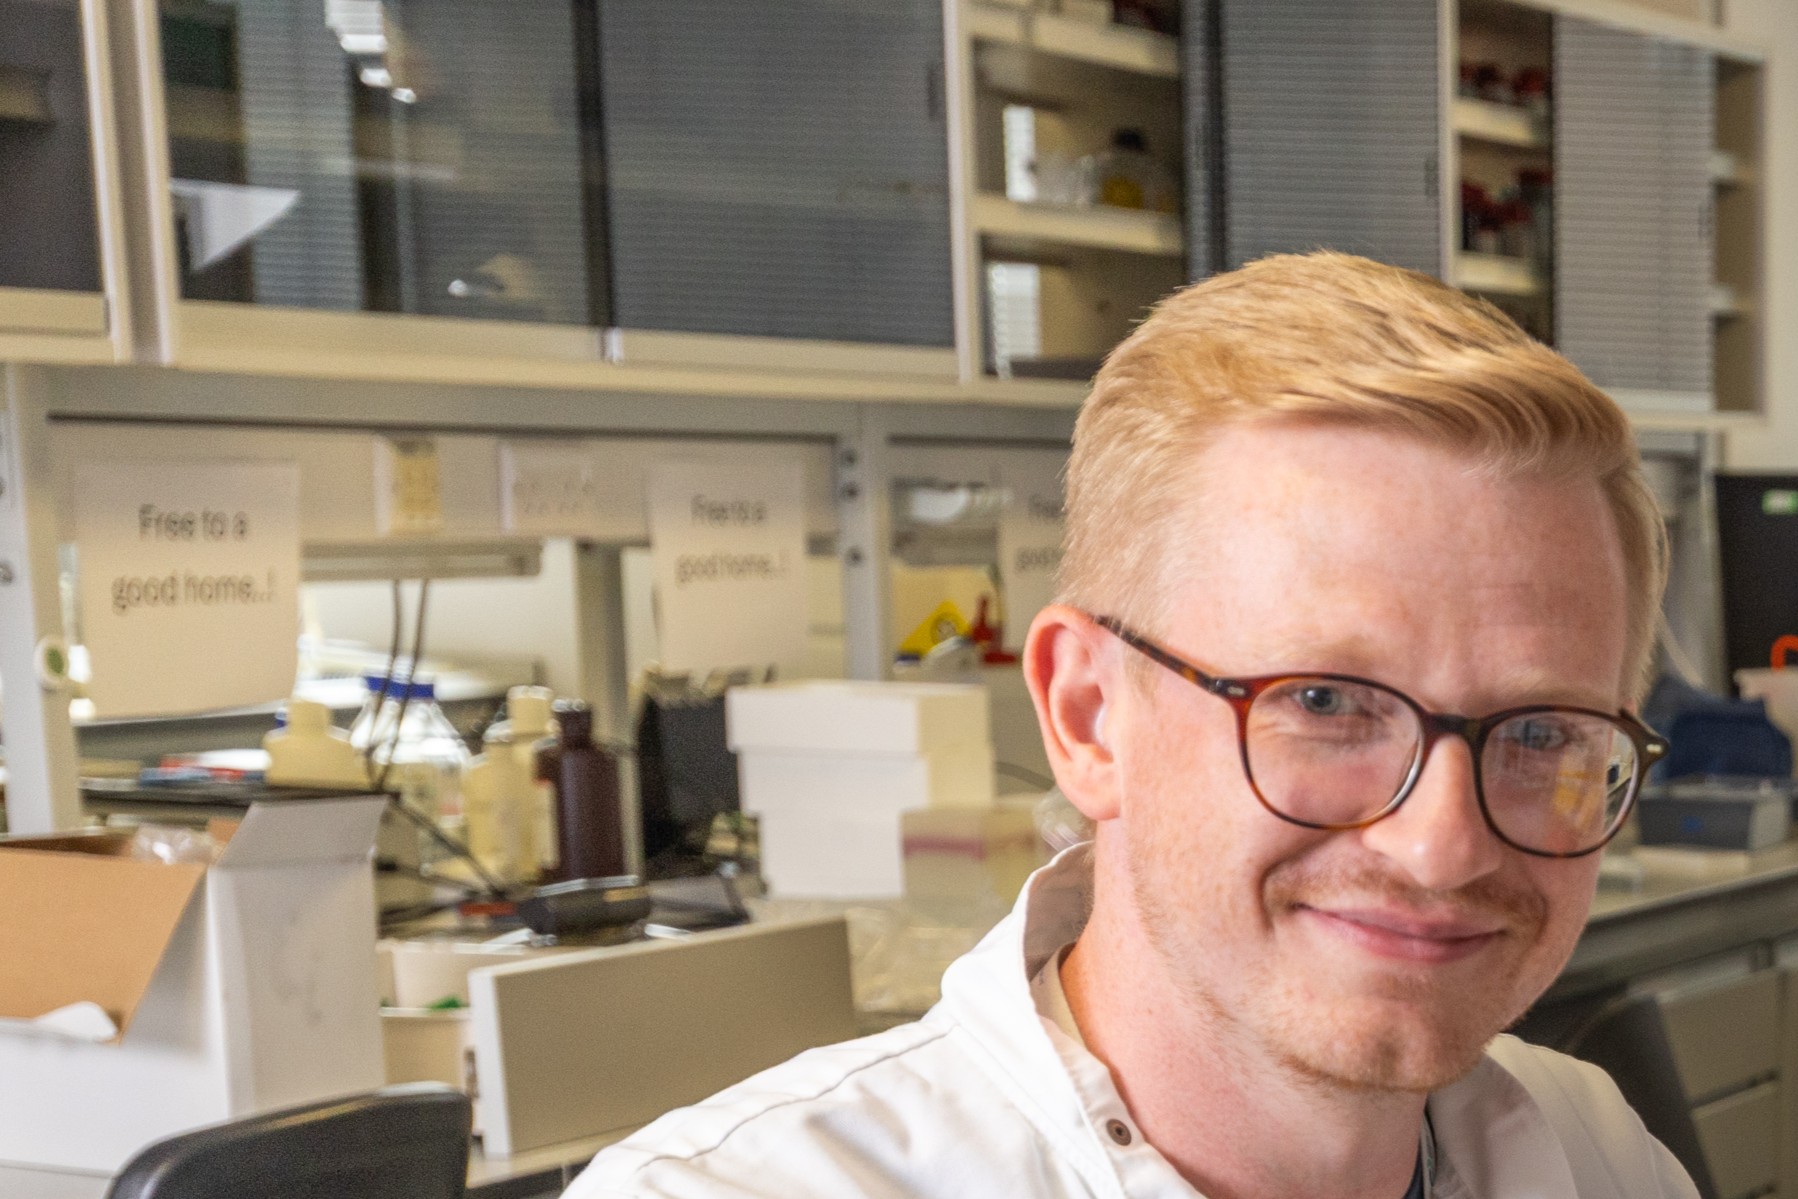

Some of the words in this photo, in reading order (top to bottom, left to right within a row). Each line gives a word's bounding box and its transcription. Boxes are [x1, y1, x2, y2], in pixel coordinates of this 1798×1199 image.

[138, 504, 196, 541] Free
[202, 508, 228, 541] to
[232, 511, 249, 541] a
[111, 570, 179, 617] good
